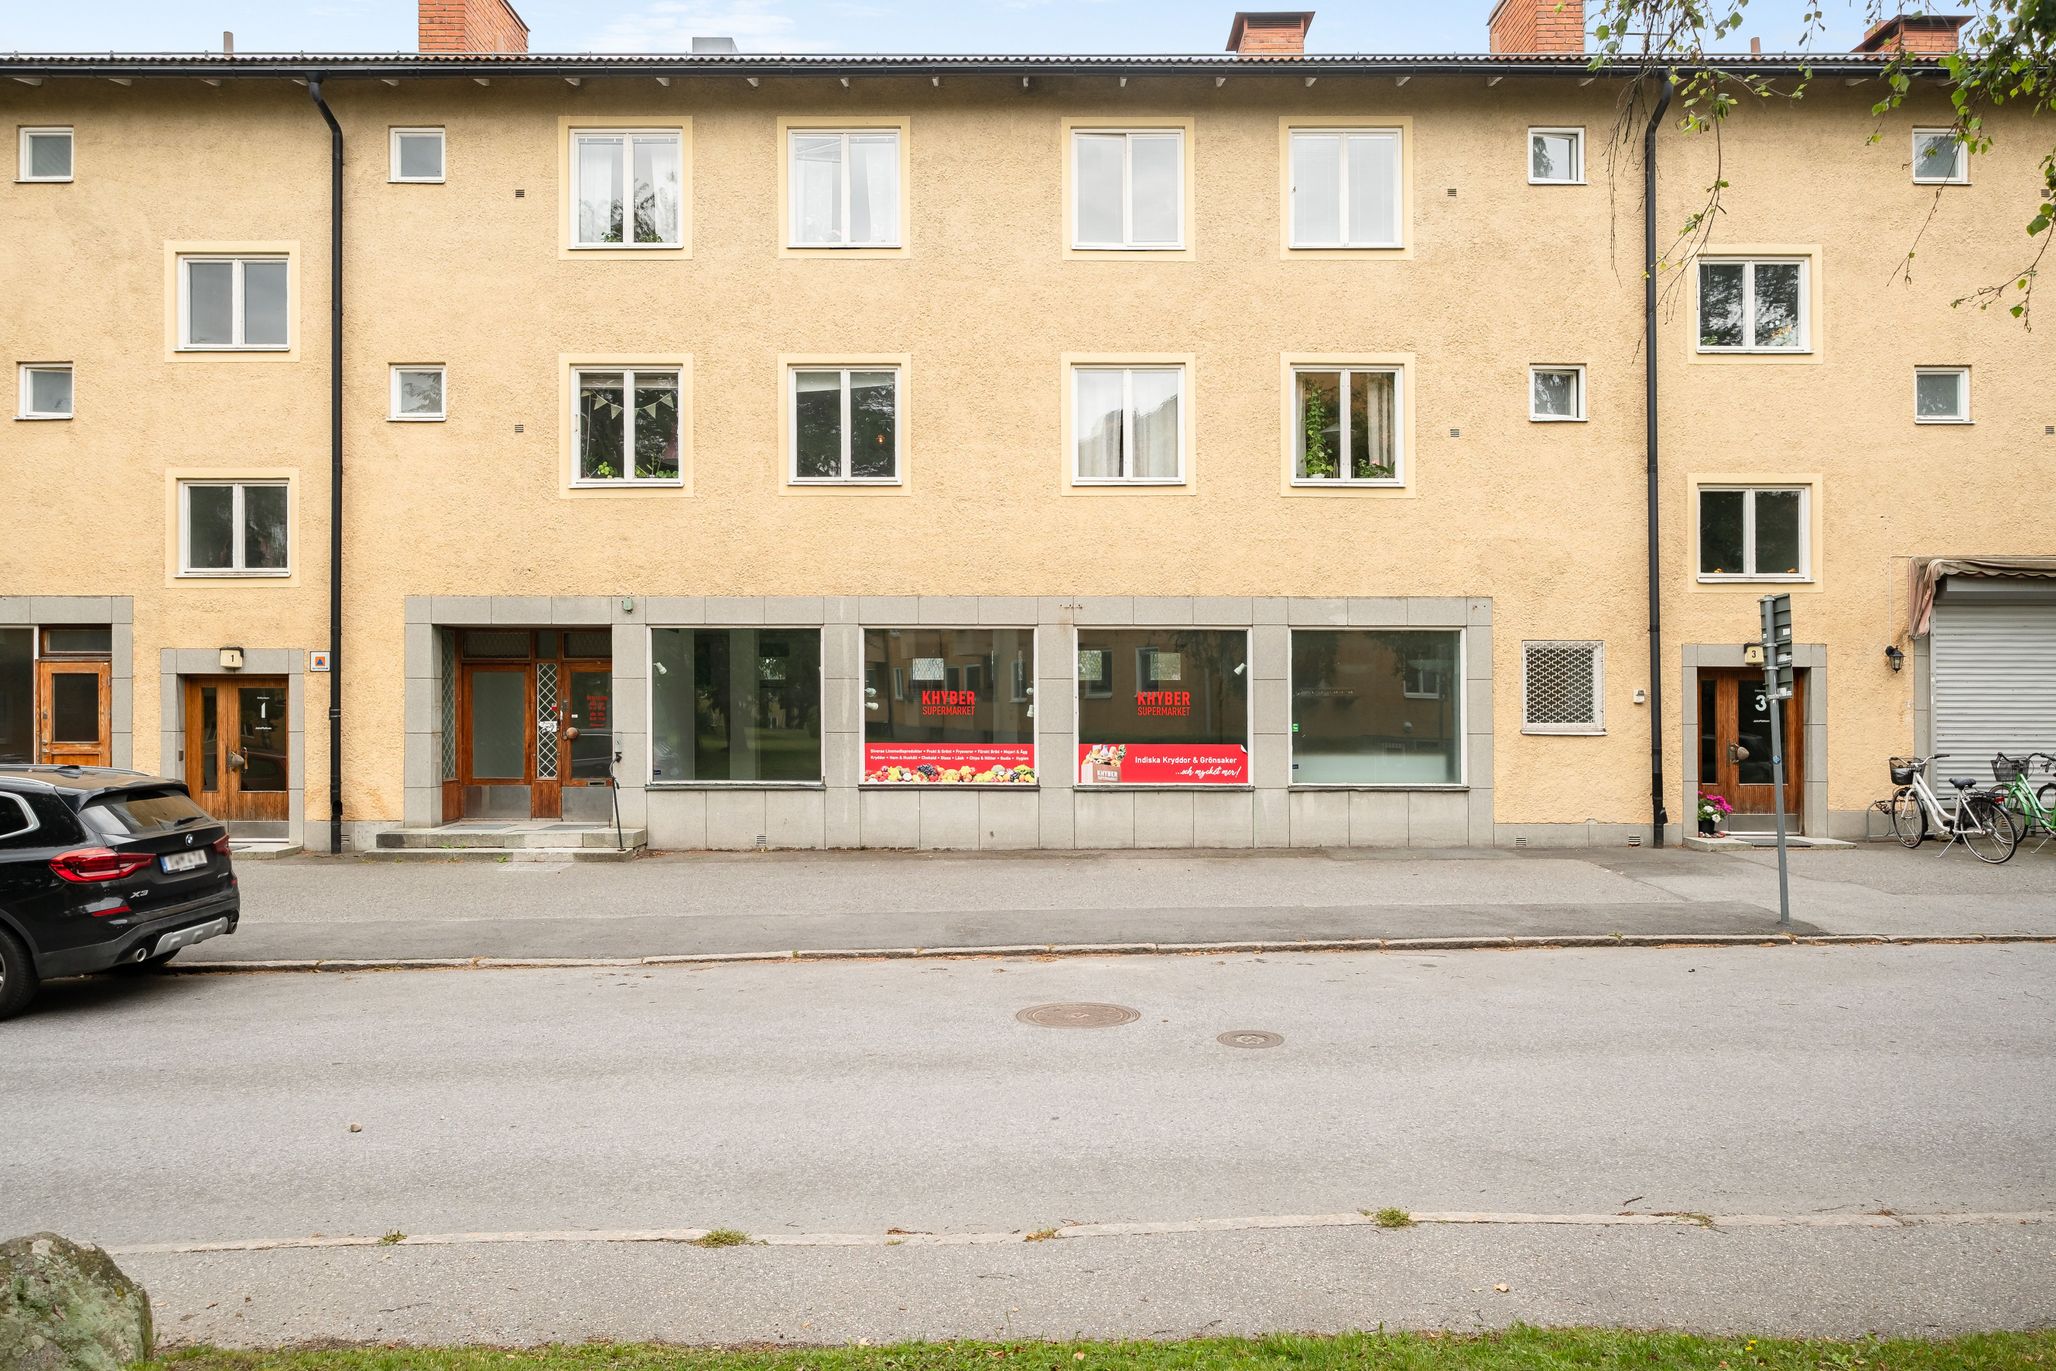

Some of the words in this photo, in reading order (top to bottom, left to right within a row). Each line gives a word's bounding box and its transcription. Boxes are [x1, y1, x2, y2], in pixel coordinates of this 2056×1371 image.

[1751, 650, 1757, 658] 3
[922, 690, 975, 705] KHYBER
[1137, 691, 1190, 706] KHYBER
[1755, 694, 1767, 711] 3
[261, 702, 266, 719] 1
[922, 706, 975, 716] SUPERMARKET
[1137, 706, 1190, 716] SUPERMARKET
[1162, 756, 1191, 764] Kryddor
[1194, 766, 1222, 779] mycket
[130, 889, 149, 899] X3
